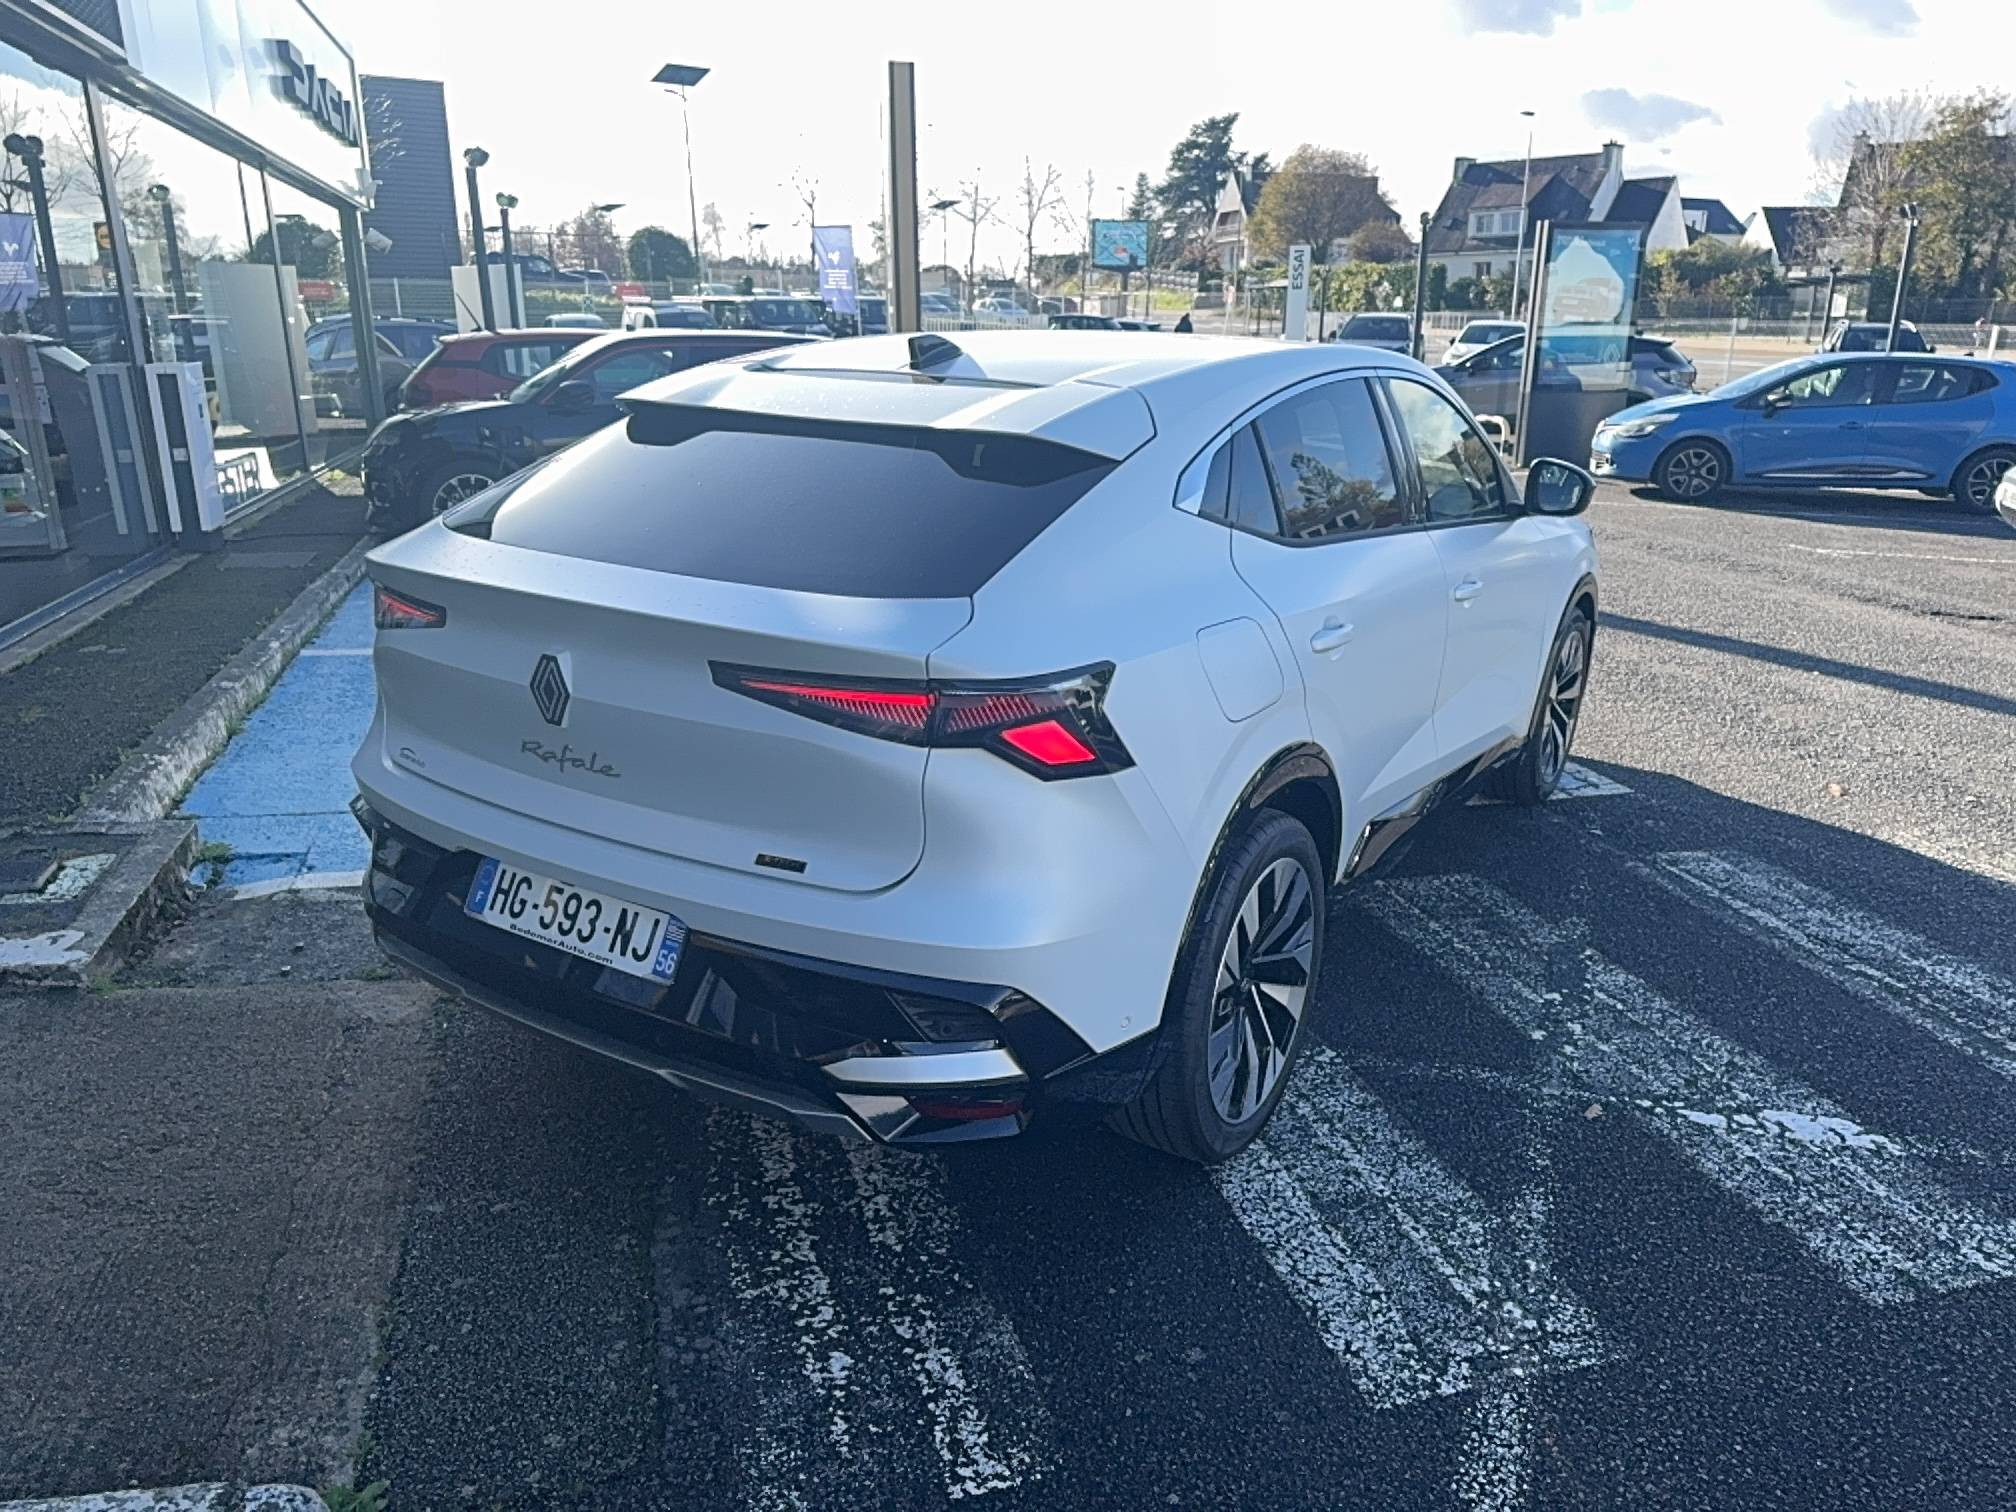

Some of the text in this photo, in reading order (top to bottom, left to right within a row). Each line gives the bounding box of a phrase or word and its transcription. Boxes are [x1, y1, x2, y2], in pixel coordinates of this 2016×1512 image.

[1292, 249, 1305, 290] ESSAI
[520, 739, 621, 778] Rafale
[475, 891, 485, 903] F
[488, 868, 661, 962] HG-593-NJ
[655, 949, 678, 974] 56
